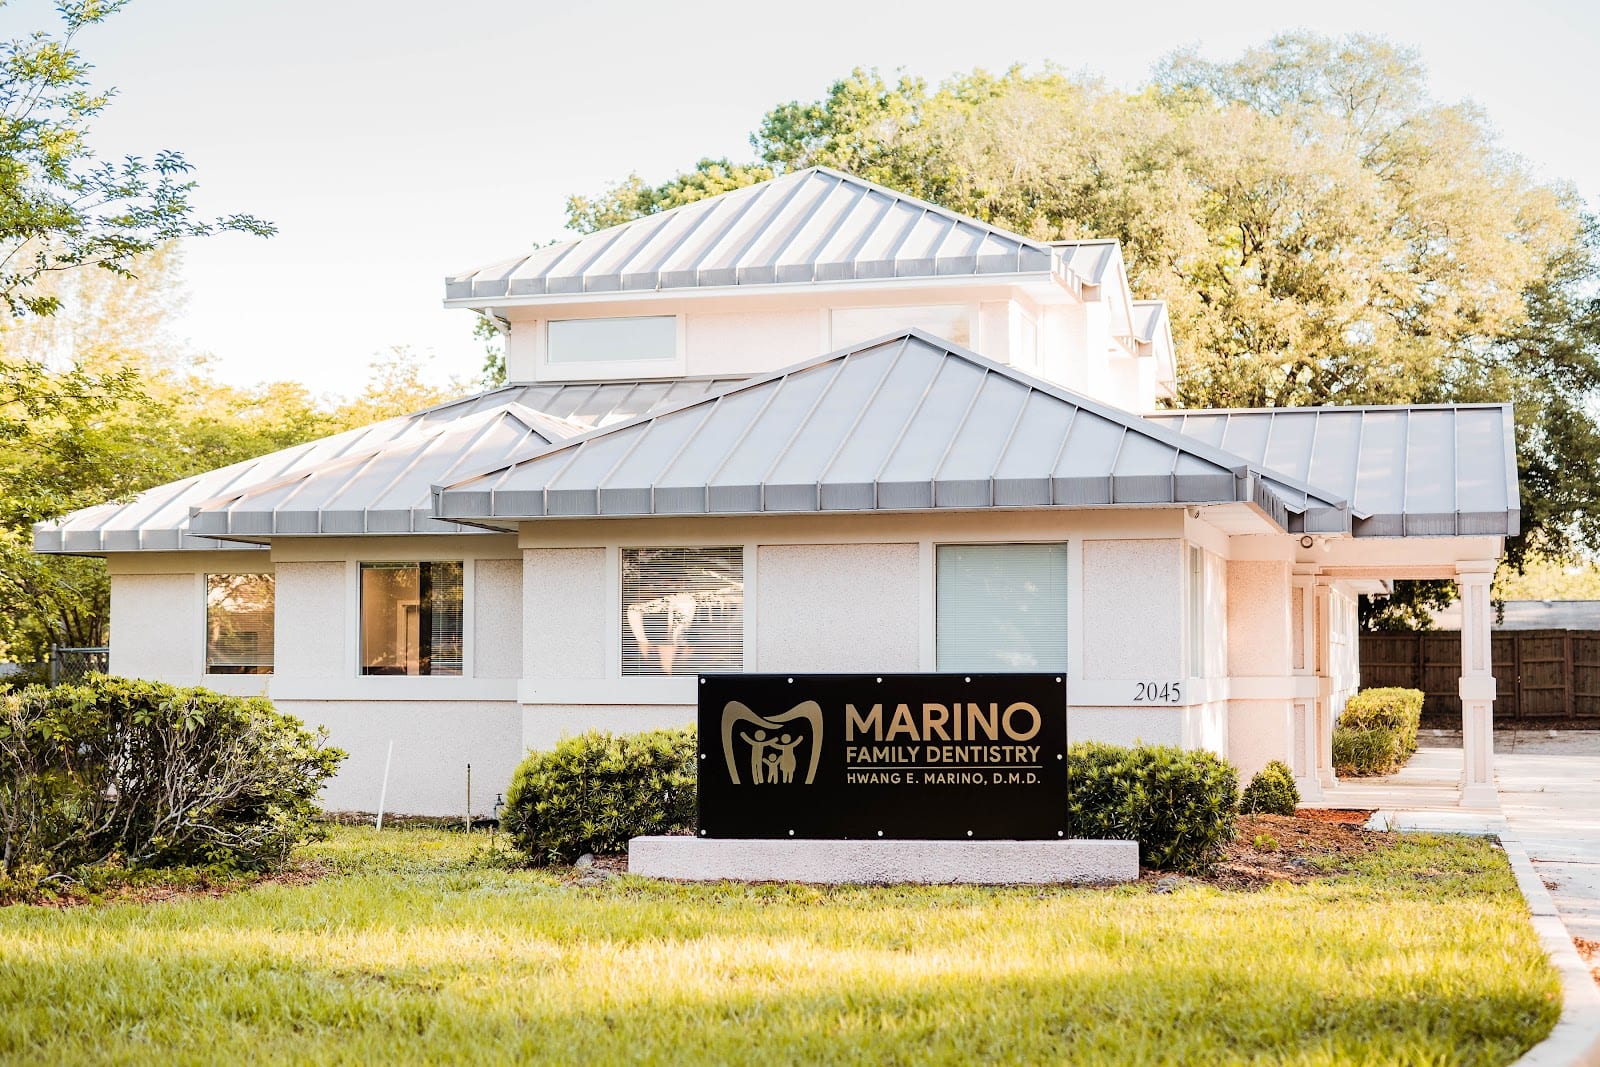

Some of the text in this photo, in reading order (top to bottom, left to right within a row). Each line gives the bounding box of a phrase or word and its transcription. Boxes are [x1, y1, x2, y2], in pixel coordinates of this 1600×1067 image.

[1133, 682, 1181, 703] 2045
[845, 702, 1042, 742] MARINO
[846, 745, 1041, 763] FAMILY DENTISTRY
[847, 772, 1041, 786] HWANG E. MARINO, D.M.D.
